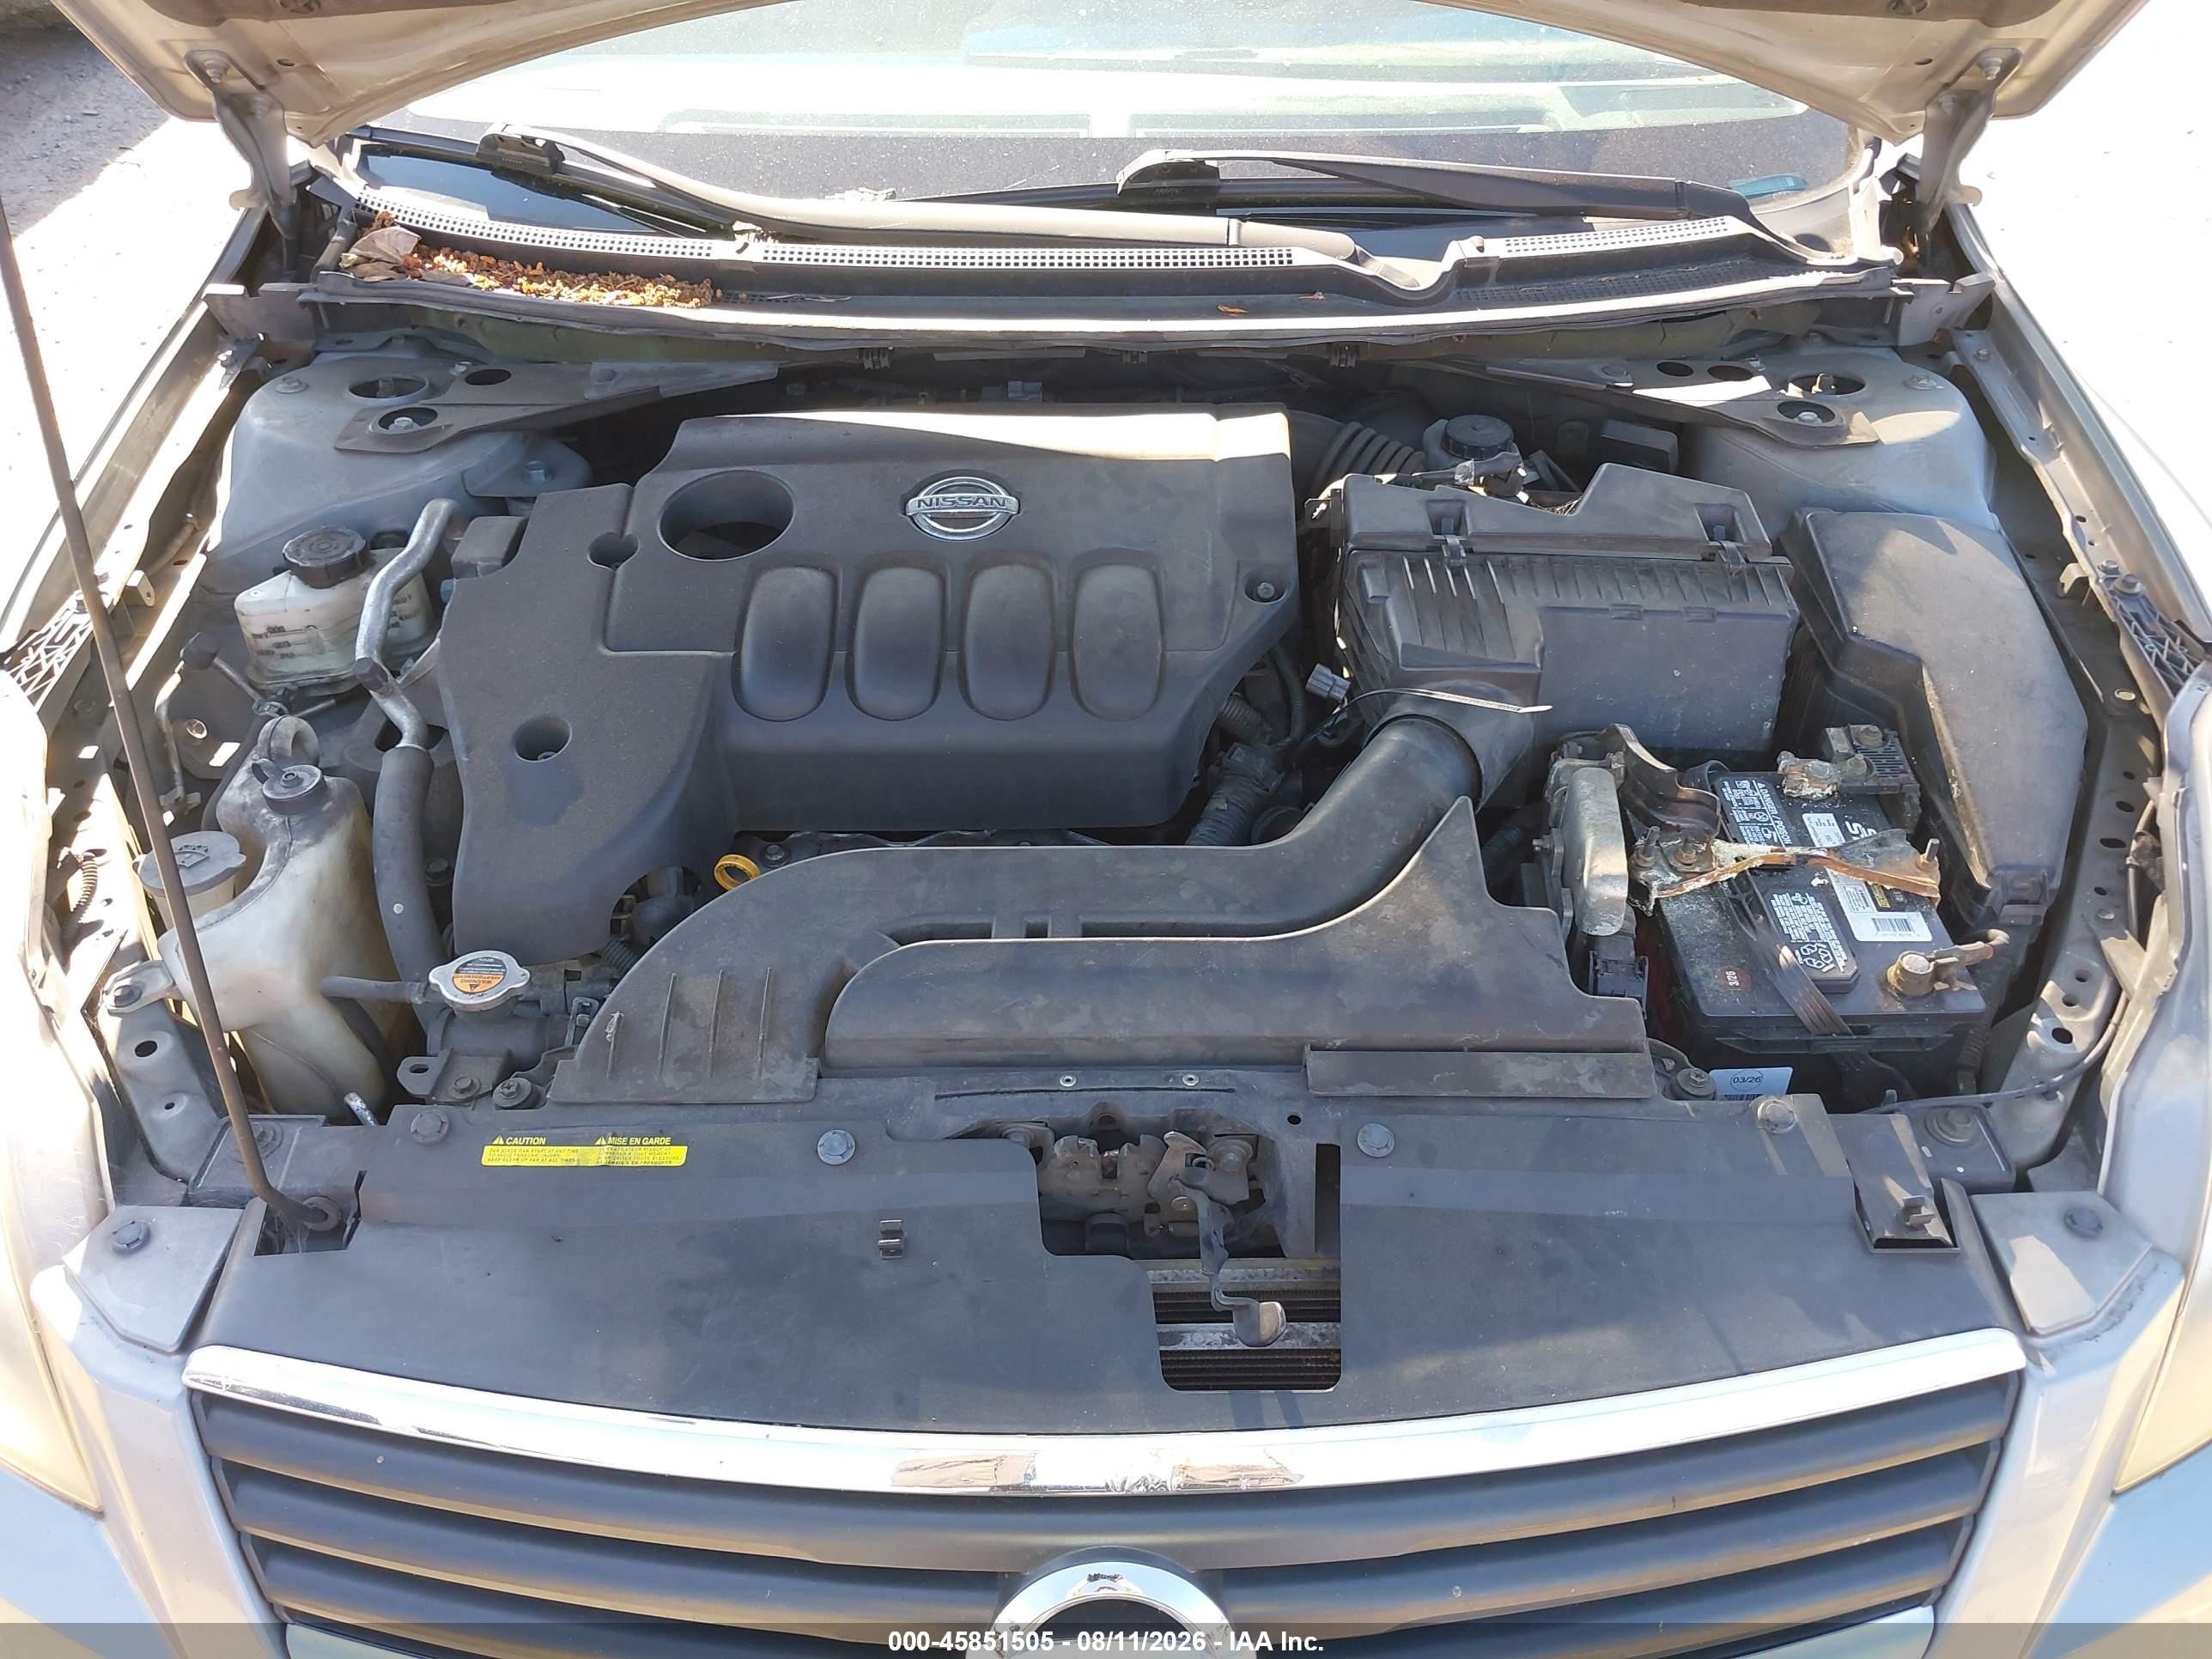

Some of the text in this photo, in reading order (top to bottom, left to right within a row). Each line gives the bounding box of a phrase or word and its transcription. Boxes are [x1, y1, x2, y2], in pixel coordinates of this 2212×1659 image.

[917, 497, 1006, 508] NISSAN
[1759, 789, 1778, 815] DANGER
[1774, 820, 1794, 845] POISON
[1725, 970, 1740, 987] 3/26
